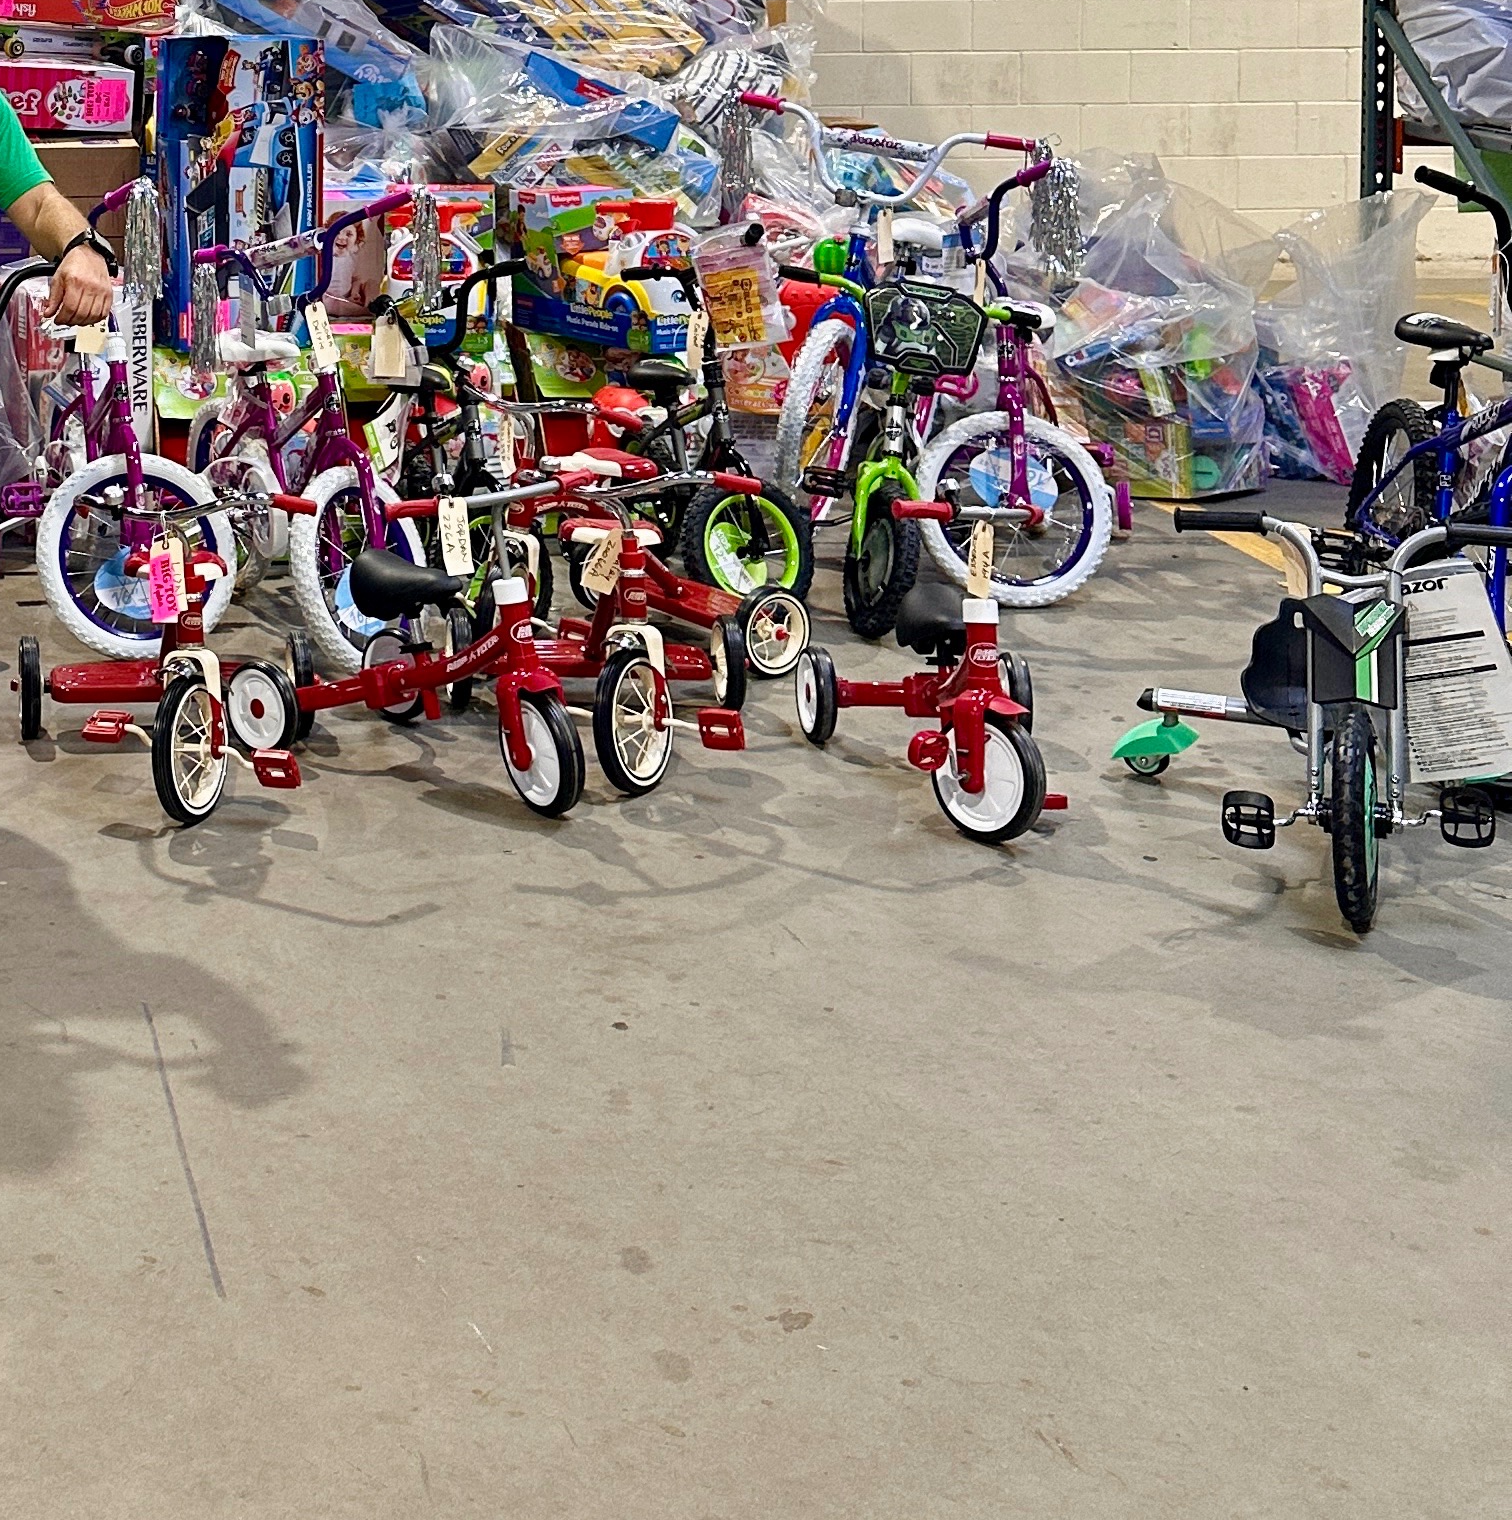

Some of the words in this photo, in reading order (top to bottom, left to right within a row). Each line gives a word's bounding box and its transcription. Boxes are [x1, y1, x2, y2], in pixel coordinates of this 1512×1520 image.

[11, 90, 41, 114] ef
[131, 297, 149, 412] ARBERWARE
[160, 558, 172, 584] BIG
[164, 585, 178, 612] TOY
[1400, 578, 1449, 597] azor
